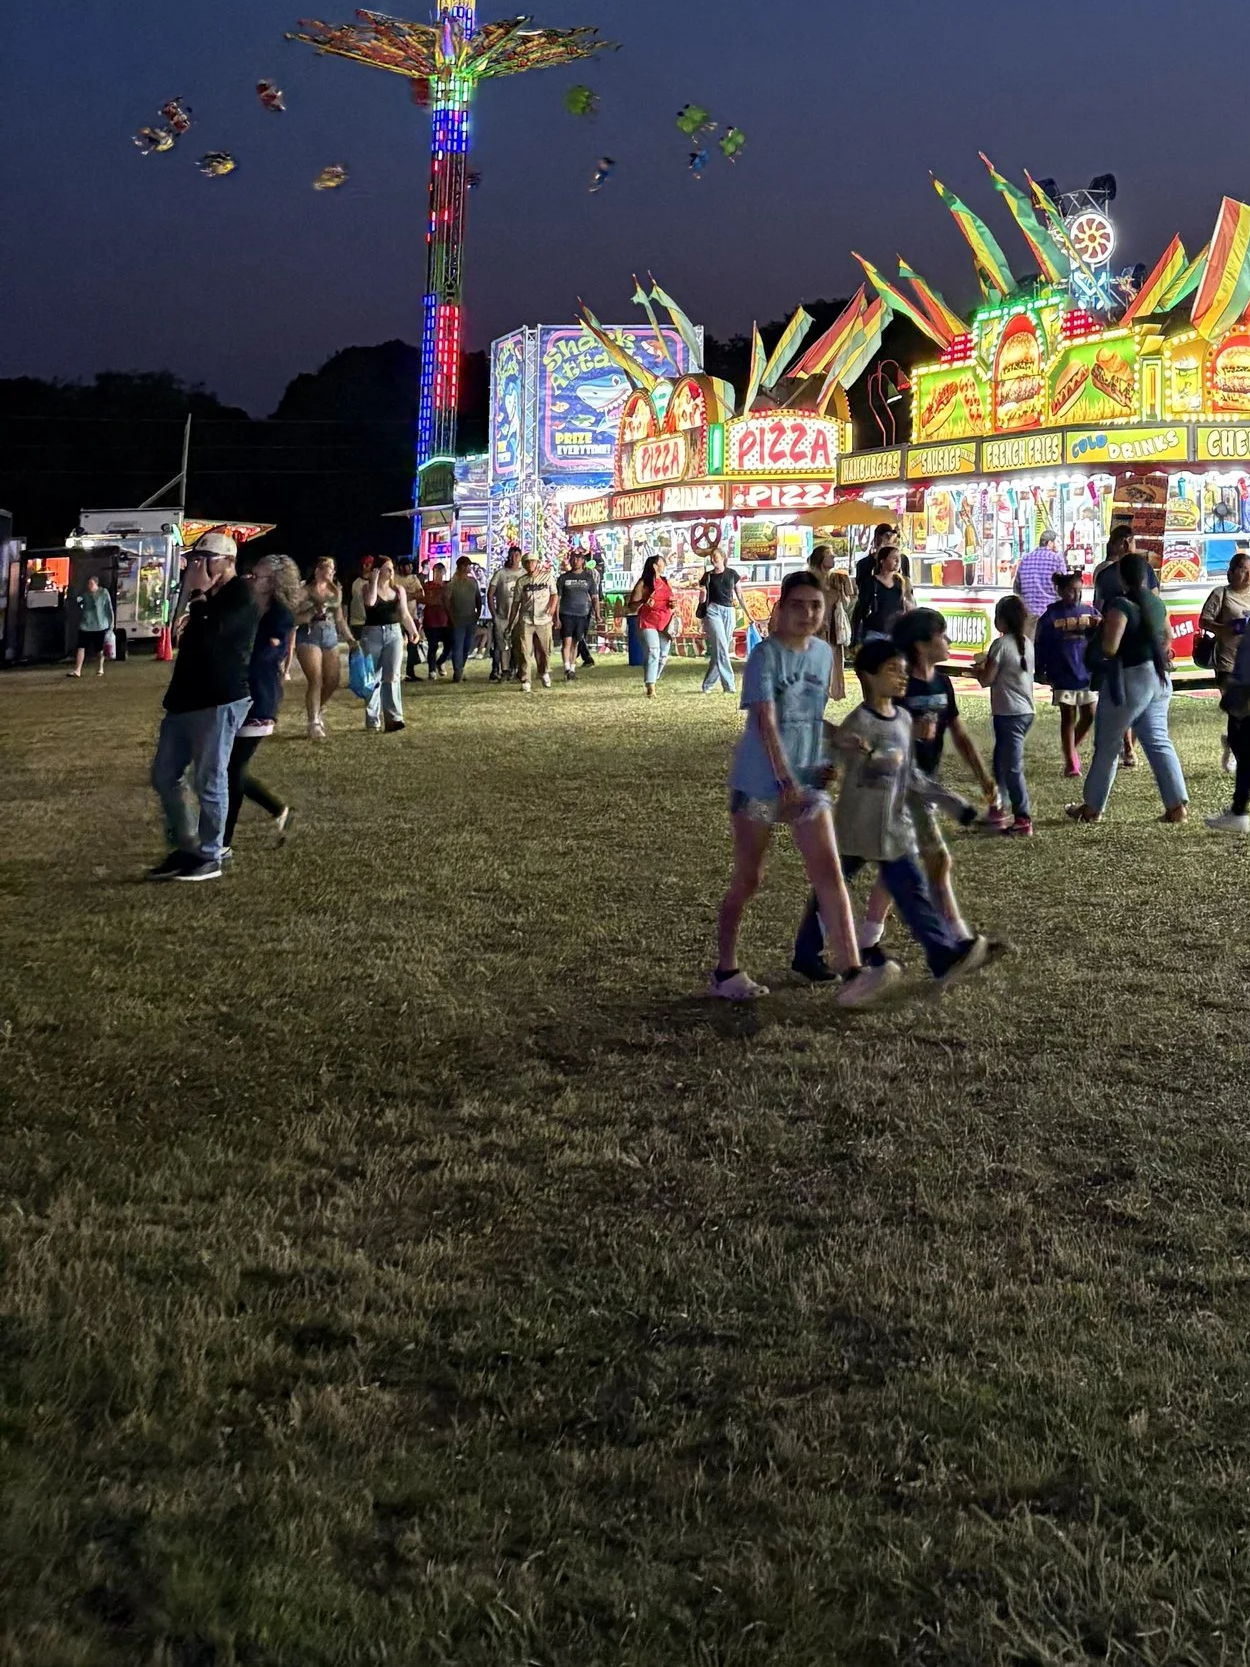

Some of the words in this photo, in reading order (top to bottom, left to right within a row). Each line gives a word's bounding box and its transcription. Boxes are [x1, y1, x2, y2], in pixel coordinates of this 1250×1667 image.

[543, 327, 636, 371] Shak
[555, 431, 592, 444] PRIZE
[737, 420, 831, 469] PIZZA
[986, 437, 1026, 470] FRENCH
[1028, 433, 1061, 465] FRIES
[1071, 432, 1108, 458] COLD
[1108, 429, 1180, 460] DRINKS
[640, 441, 681, 481] PIZZA
[843, 453, 900, 483] HAMBURGERS
[921, 446, 961, 474] SAUSAGE
[571, 499, 609, 525] CALZONES
[1170, 619, 1195, 639] LISH
